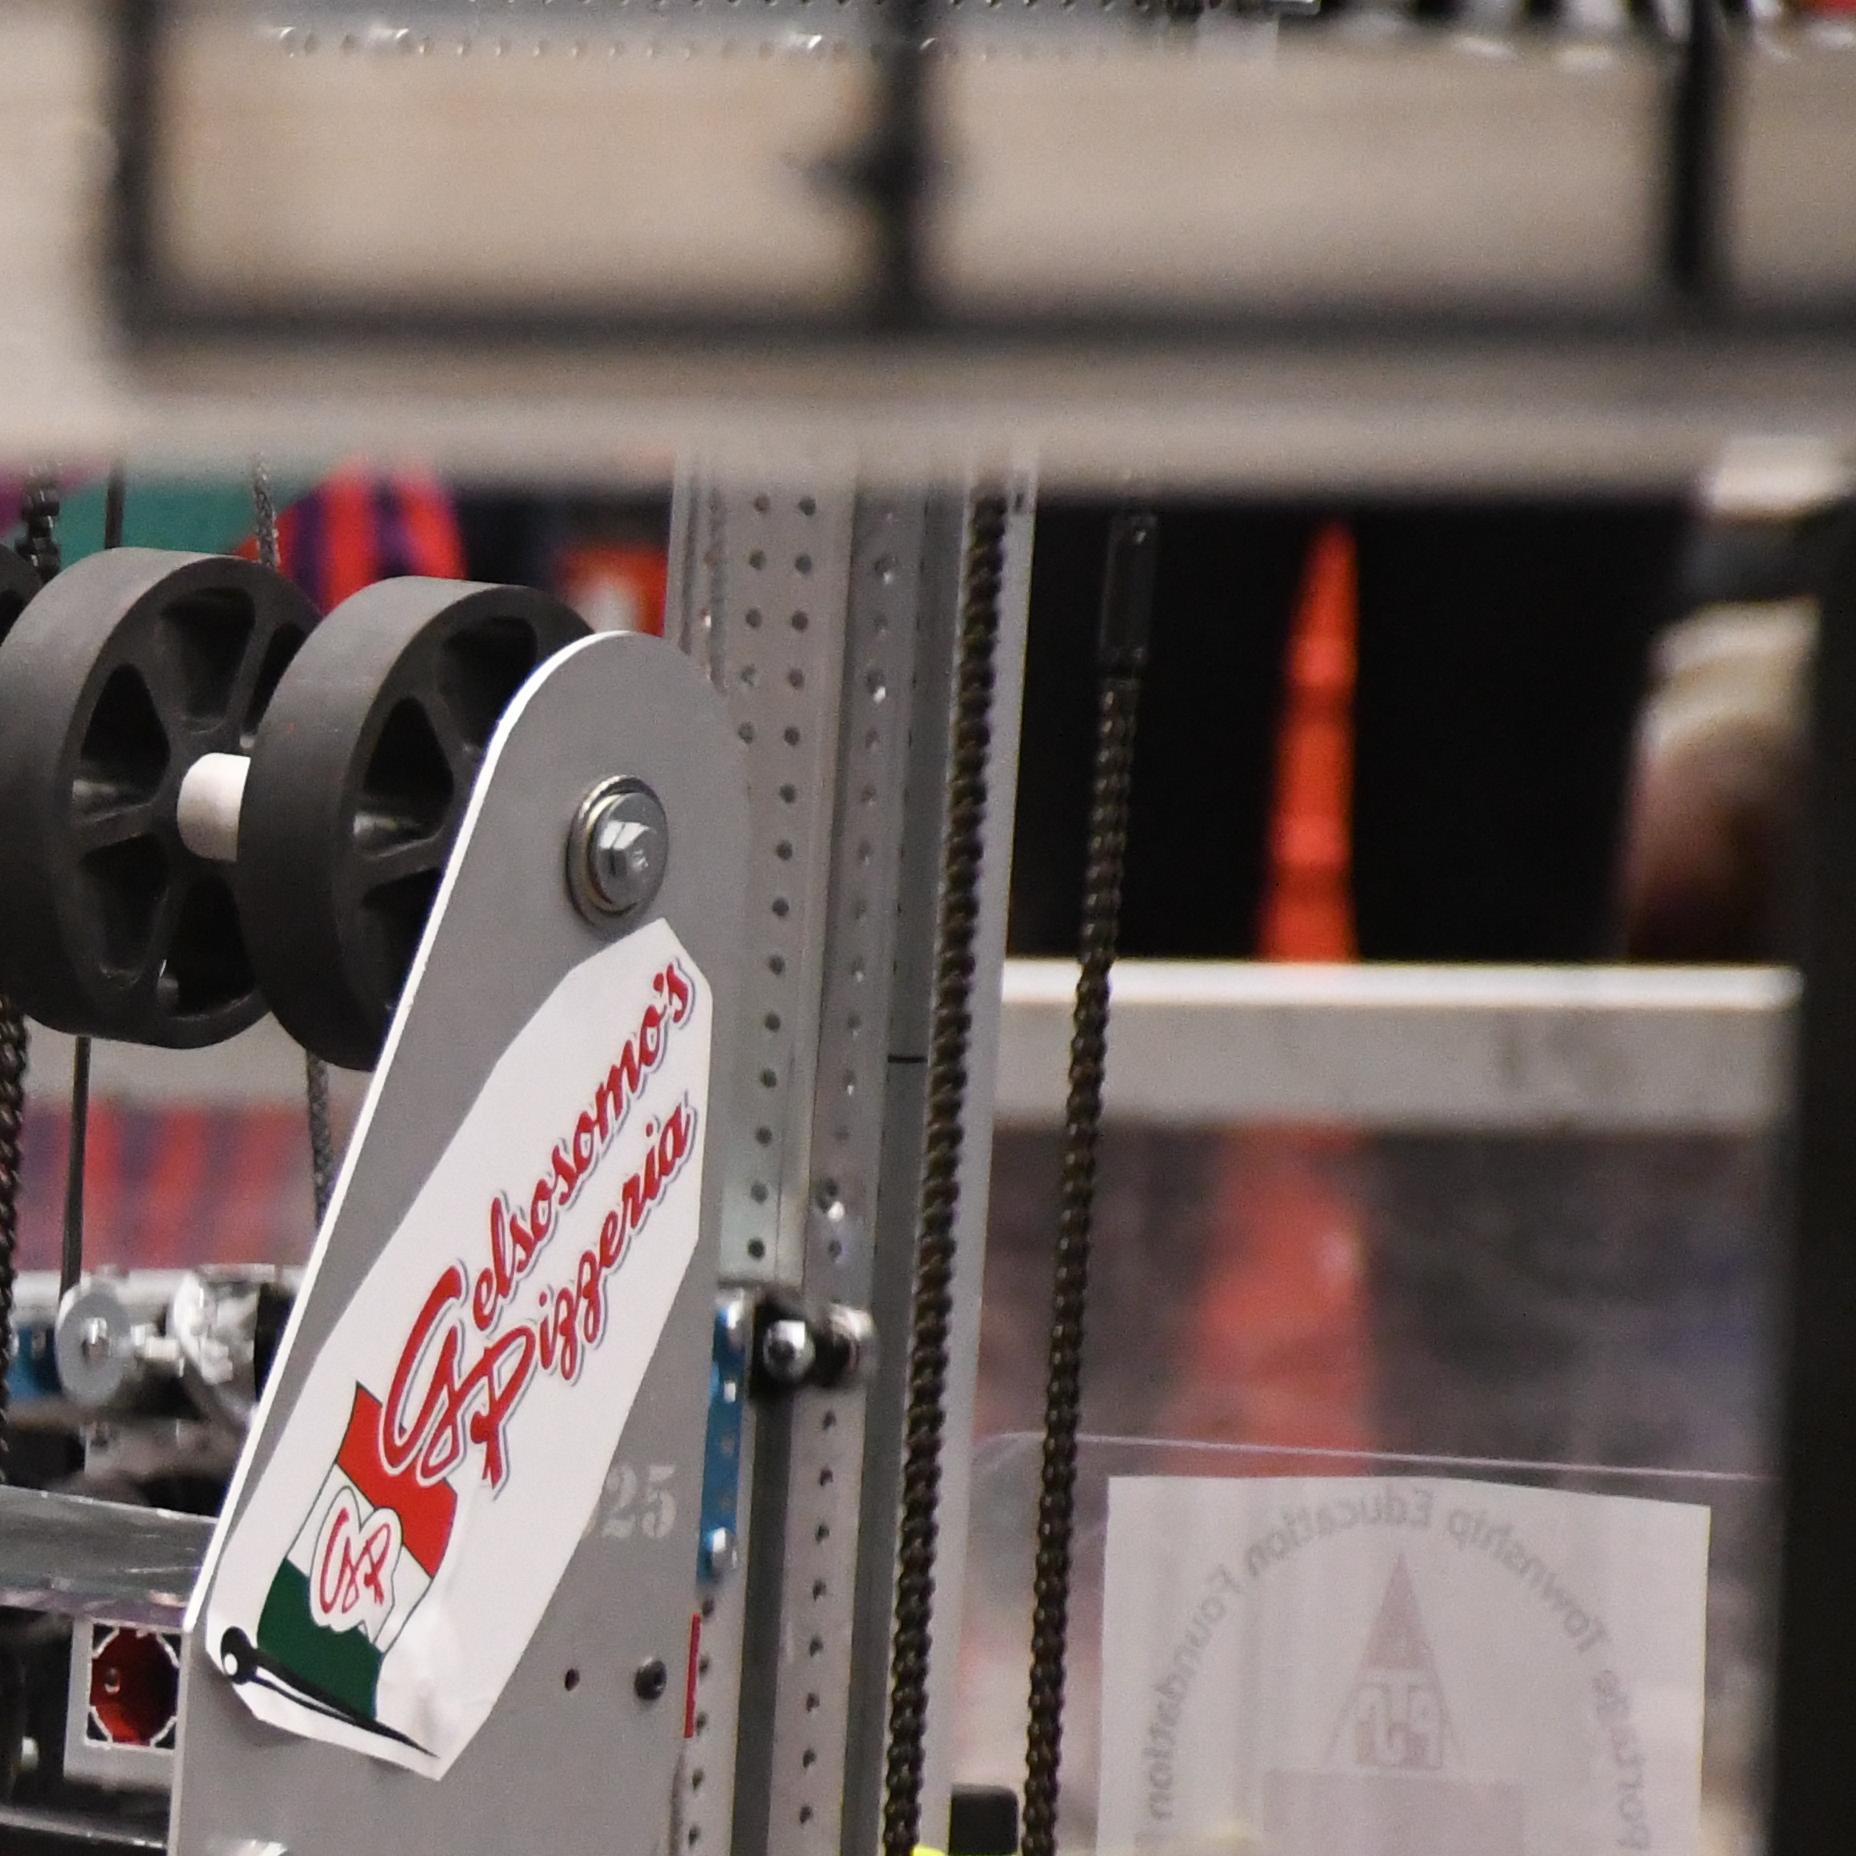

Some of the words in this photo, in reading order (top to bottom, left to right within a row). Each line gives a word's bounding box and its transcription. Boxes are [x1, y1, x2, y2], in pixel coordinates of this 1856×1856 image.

[380, 957, 693, 1480] Gelsosomo's
[470, 1104, 694, 1482] Pizzeria
[588, 1463, 677, 1538] 25
